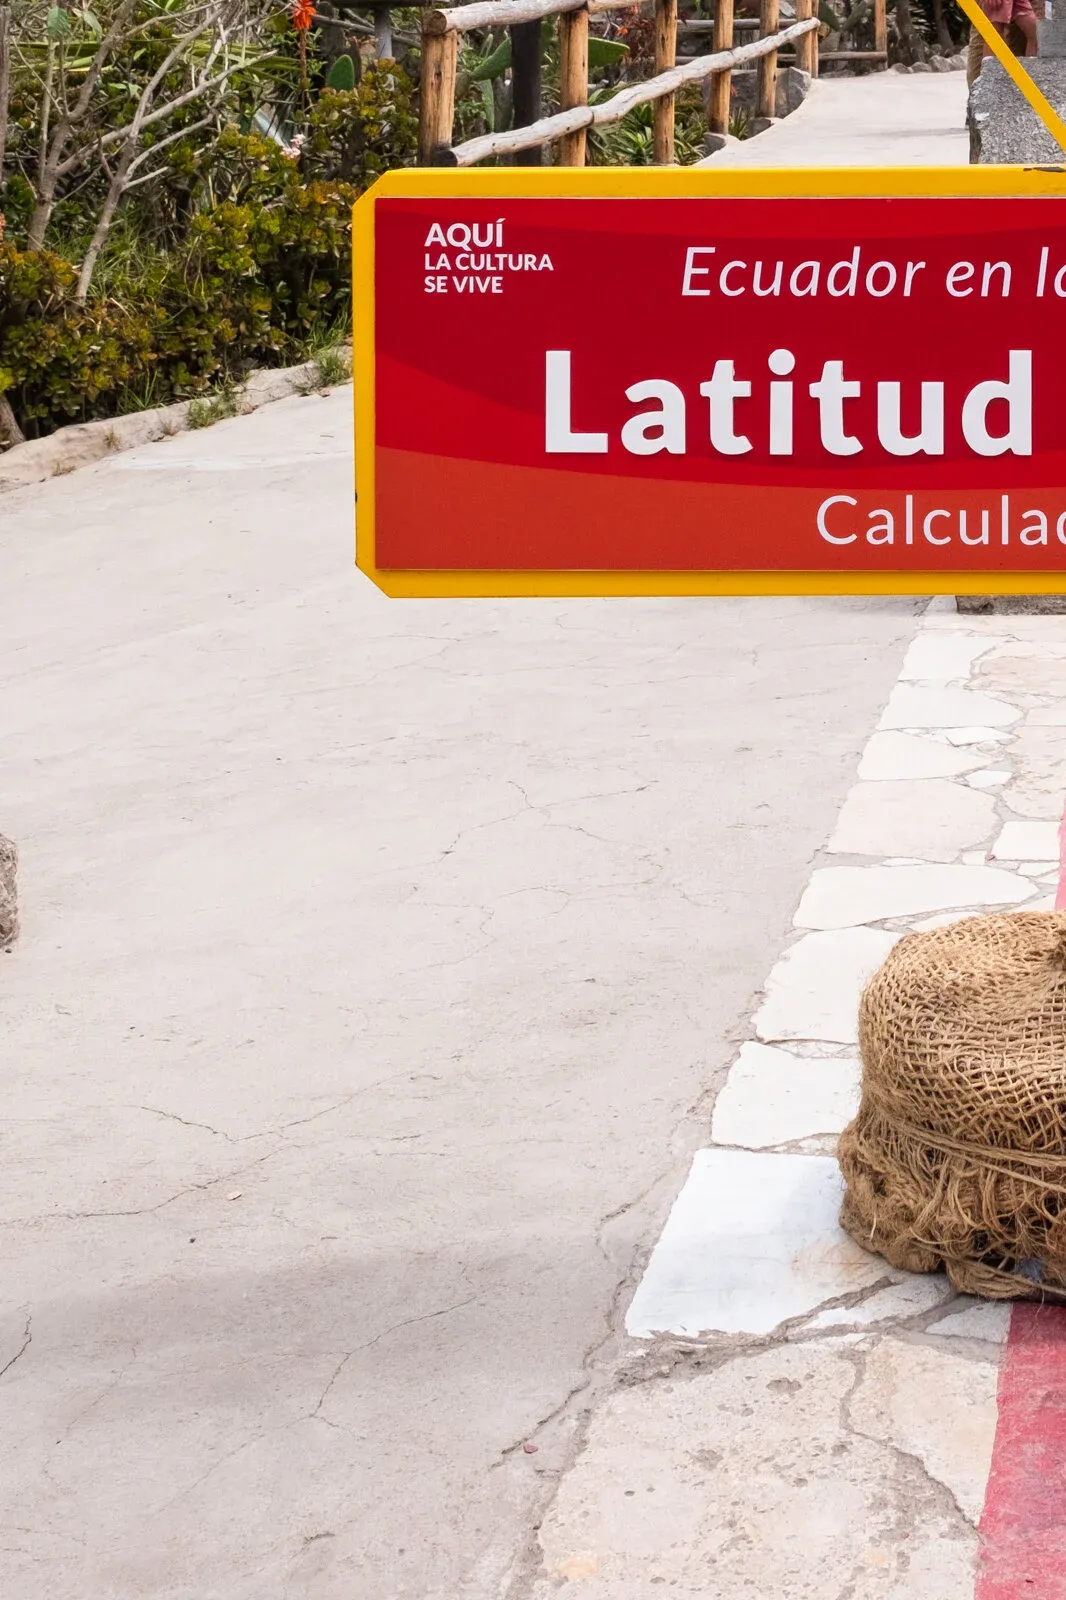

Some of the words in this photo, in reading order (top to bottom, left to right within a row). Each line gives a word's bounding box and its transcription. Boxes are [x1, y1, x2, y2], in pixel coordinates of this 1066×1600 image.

[424, 217, 504, 250] AQUÍ
[424, 253, 452, 271] LA
[455, 253, 554, 271] CULTURA
[681, 245, 926, 298] Ecuador
[945, 261, 1012, 298] en
[424, 275, 448, 293] SE
[452, 275, 503, 294] VIVE
[545, 348, 1033, 457] Latitud
